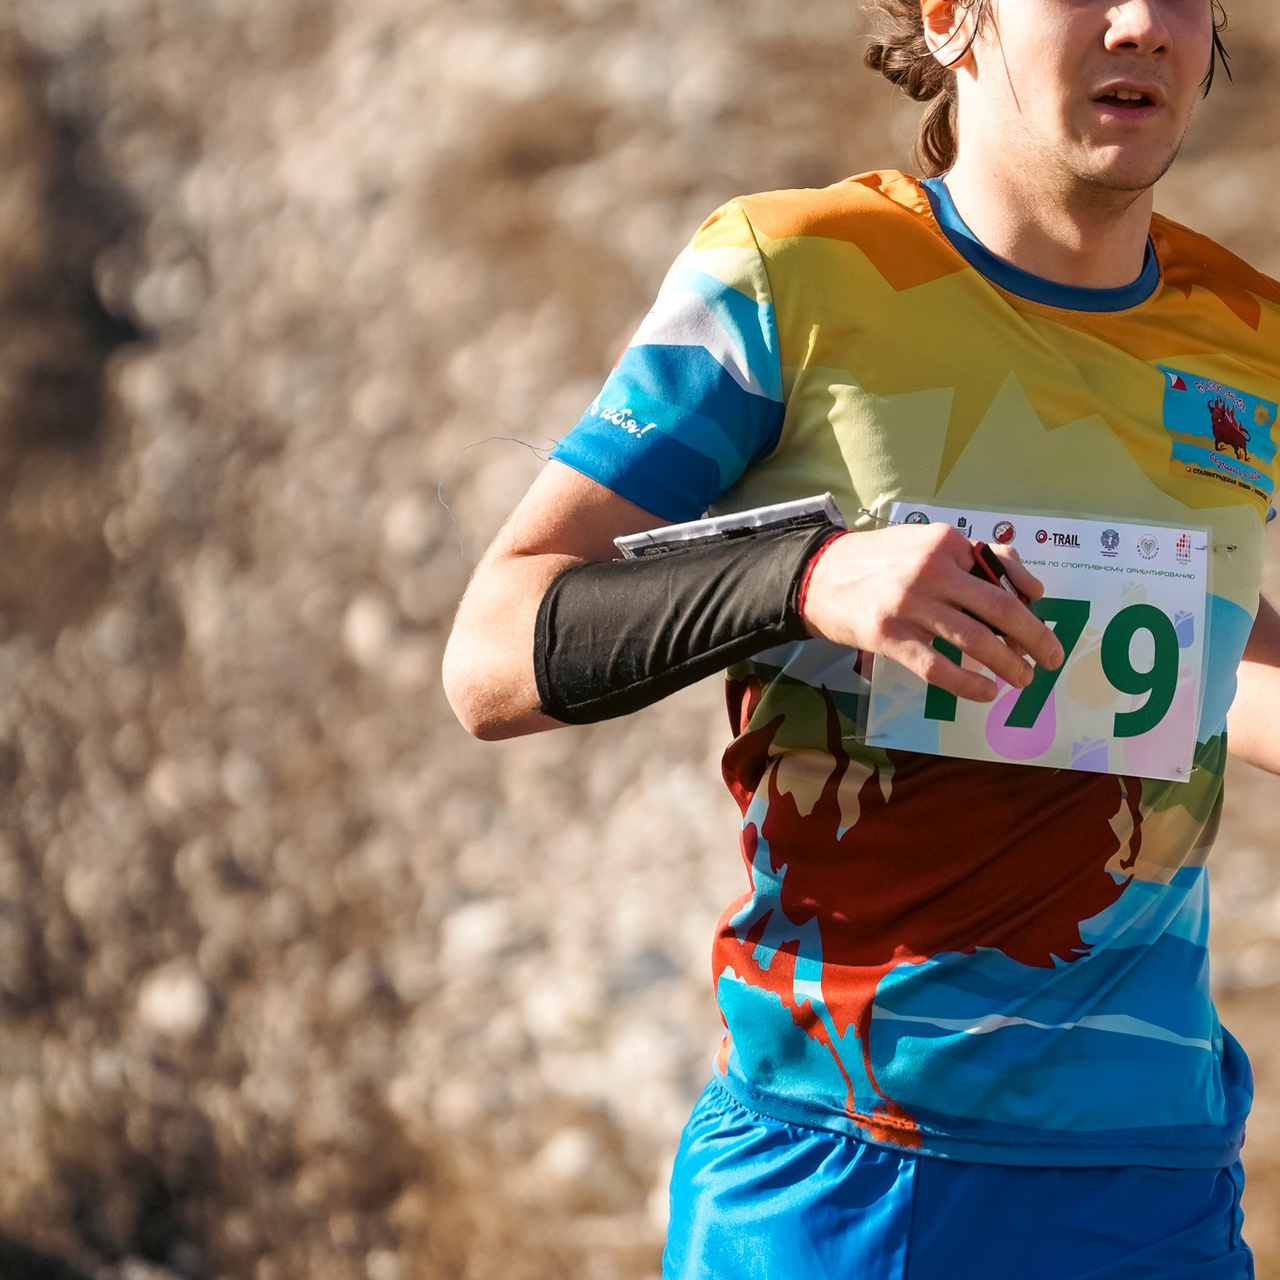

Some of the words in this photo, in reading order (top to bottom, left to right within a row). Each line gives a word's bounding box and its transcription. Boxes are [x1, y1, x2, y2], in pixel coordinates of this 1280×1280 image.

[1048, 560, 1059, 568] ПО
[1061, 561, 1124, 573] СПОРТИВНОМУ
[1126, 567, 1196, 580] ОРИЕНТИРОВАНИЮ
